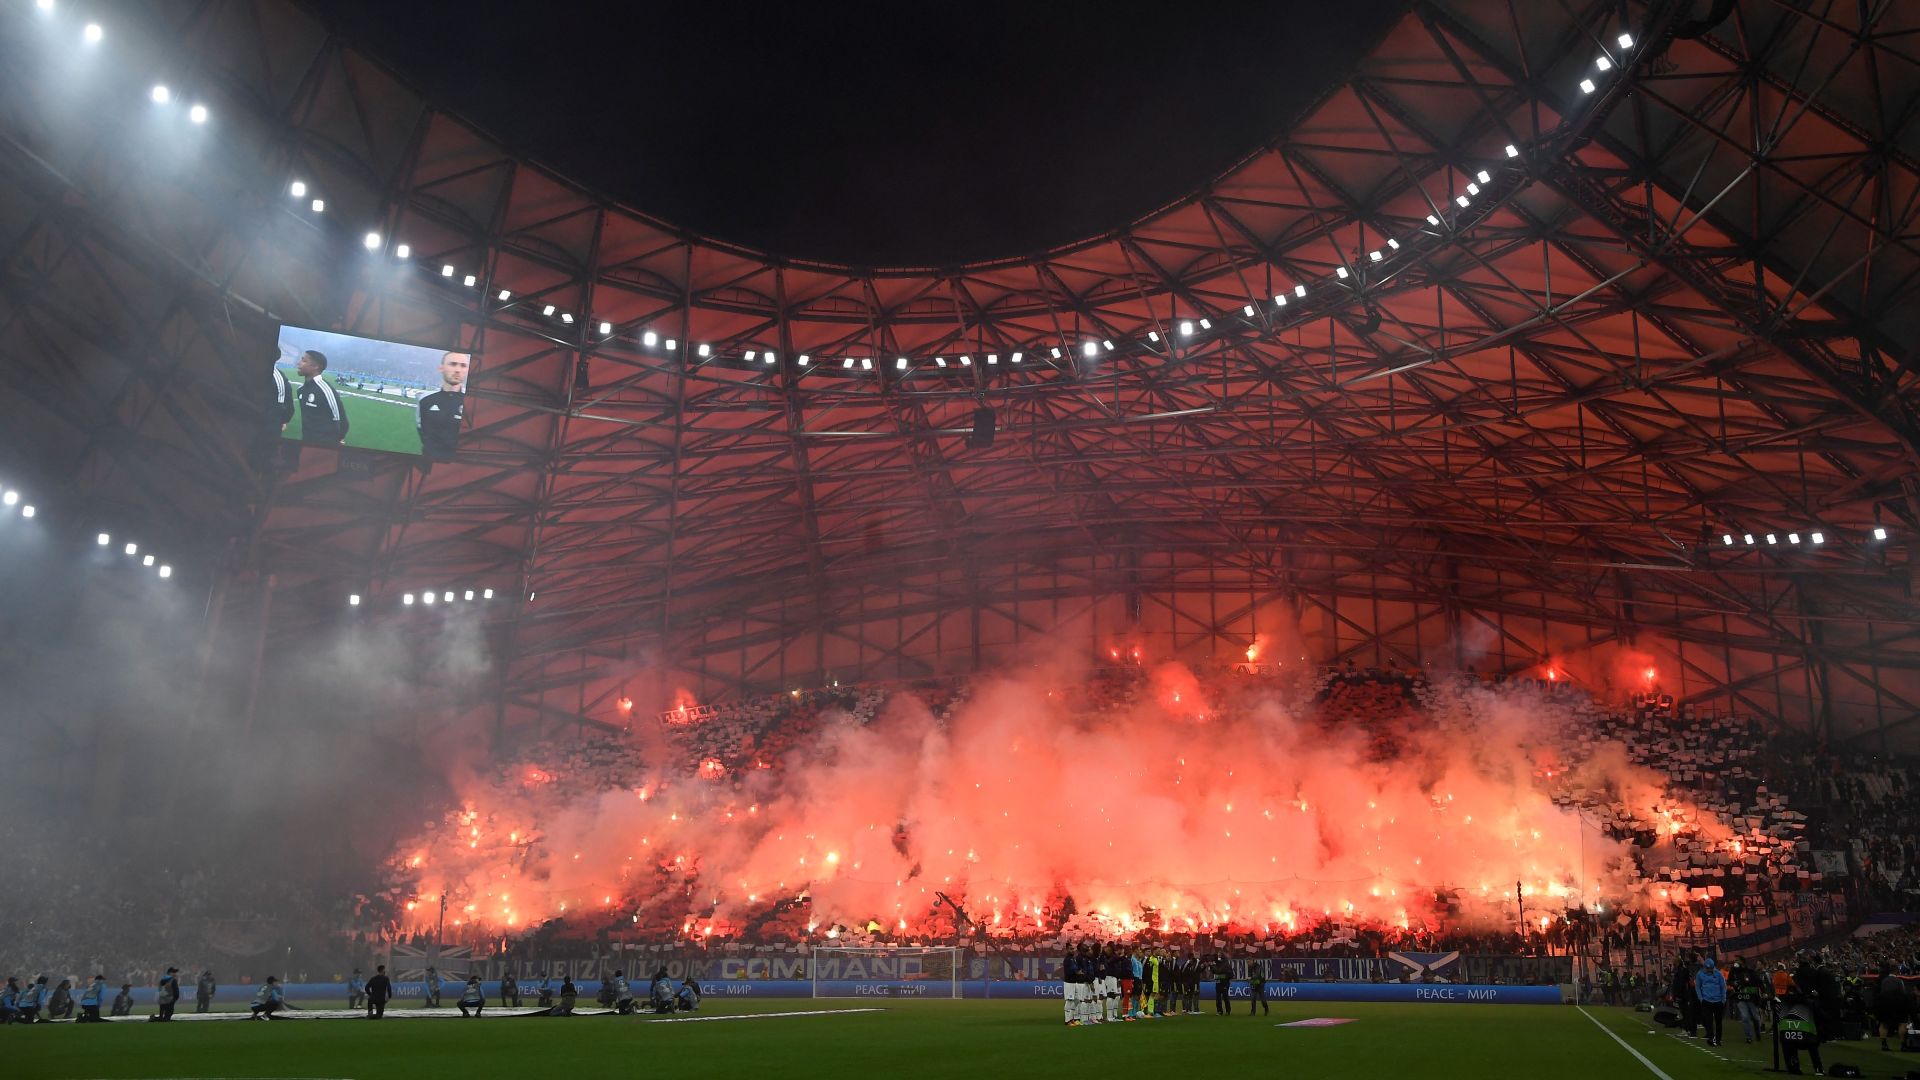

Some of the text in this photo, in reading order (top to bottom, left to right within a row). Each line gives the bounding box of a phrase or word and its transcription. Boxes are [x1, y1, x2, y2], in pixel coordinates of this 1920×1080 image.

[518, 985, 542, 995] PEAC
[727, 984, 752, 995] МИР
[855, 984, 889, 995] PEACE
[1034, 985, 1063, 996] PEAC
[1227, 986, 1298, 997] EAC МИР
[1416, 988, 1456, 999] PEACE
[1467, 989, 1497, 1000] МИР
[1786, 1020, 1801, 1029] TV
[1785, 1031, 1804, 1040] 025
